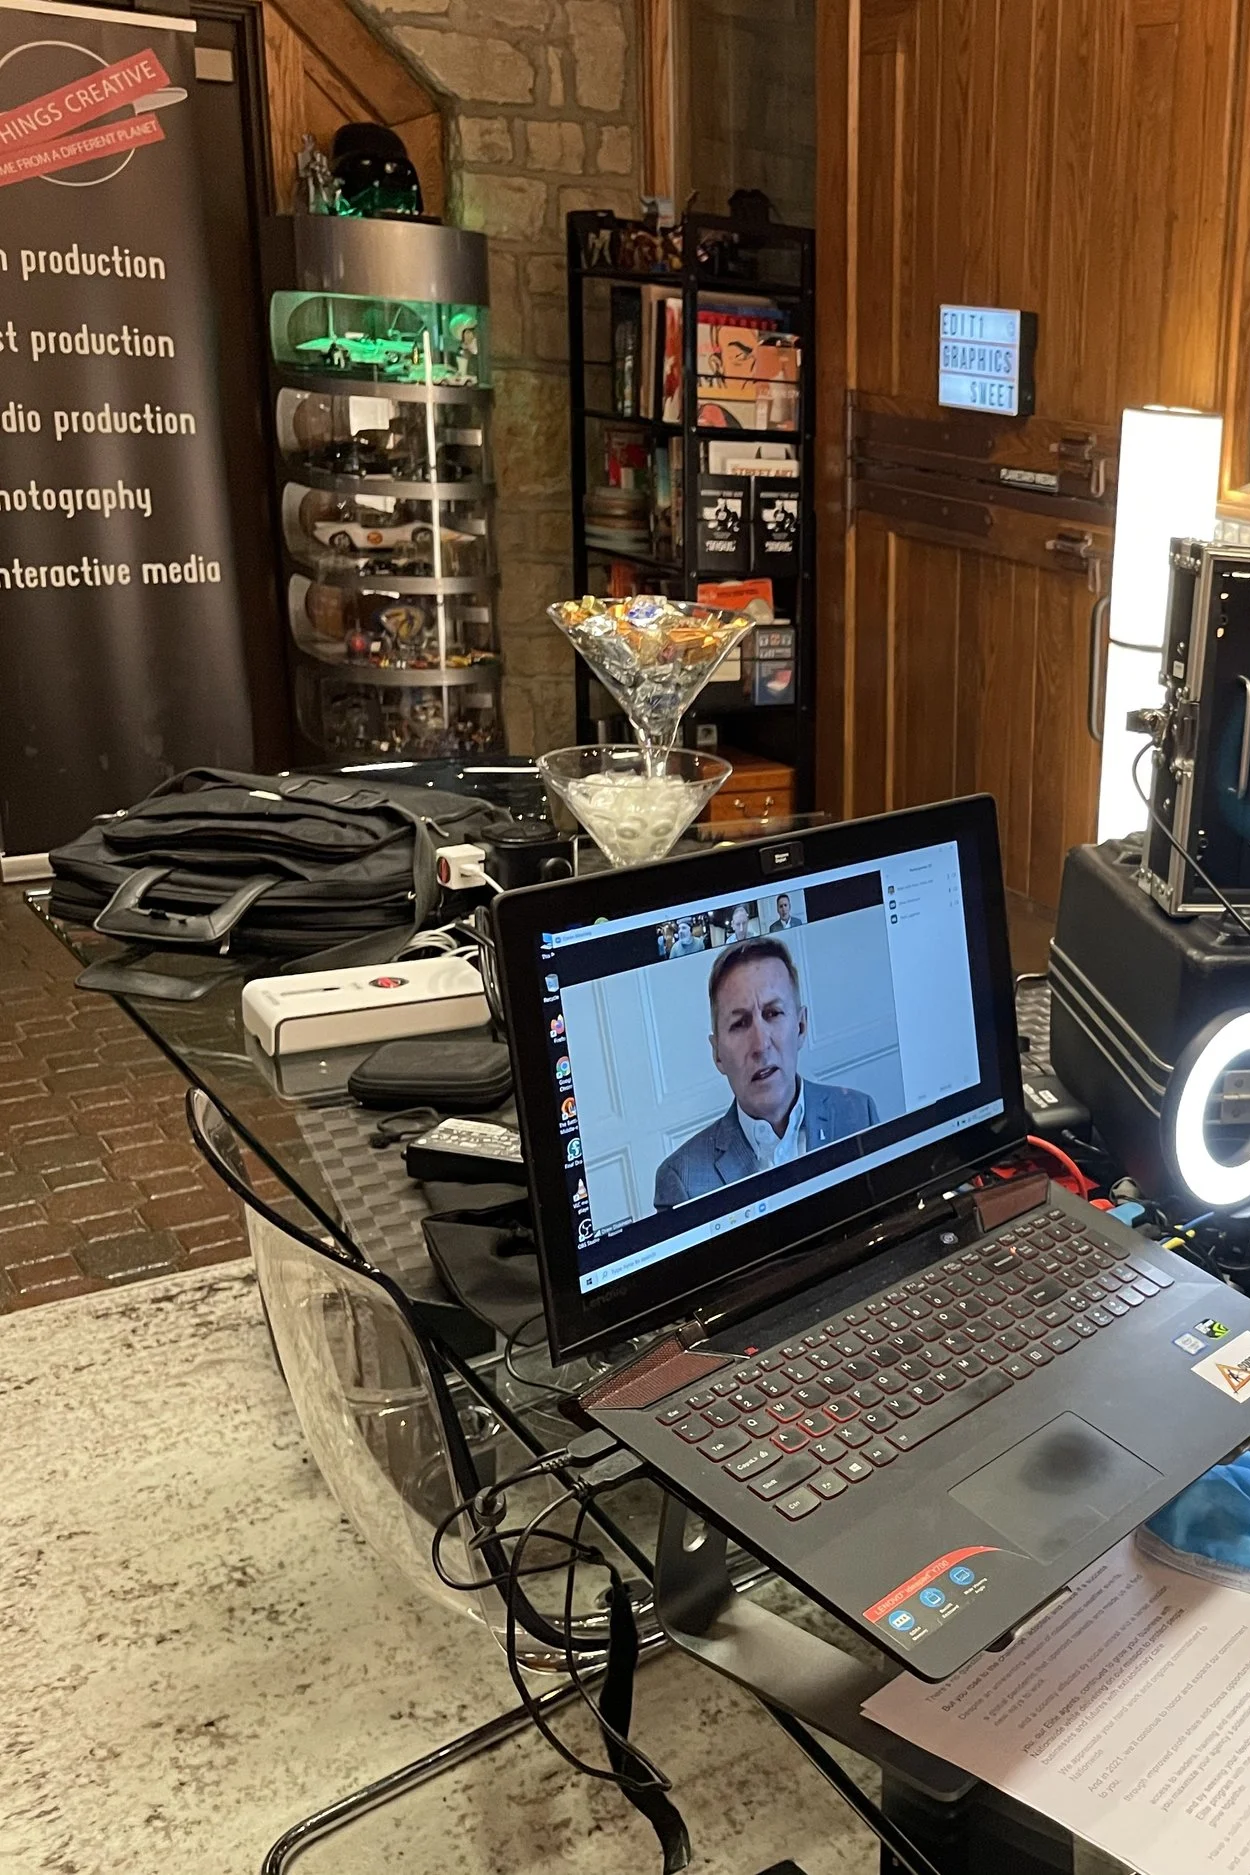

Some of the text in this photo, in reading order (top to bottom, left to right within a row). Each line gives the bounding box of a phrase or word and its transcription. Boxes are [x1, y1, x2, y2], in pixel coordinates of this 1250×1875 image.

[0, 60, 157, 144] HINGS CREATIVE
[18, 152, 51, 171] FROM
[52, 149, 61, 161] A
[60, 132, 117, 159] DIFFERENT
[117, 119, 158, 144] PLANET
[20, 243, 167, 281] production
[31, 323, 175, 361] production
[942, 344, 1013, 374] GRAPHICS
[54, 402, 197, 441] production
[142, 554, 222, 585] media
